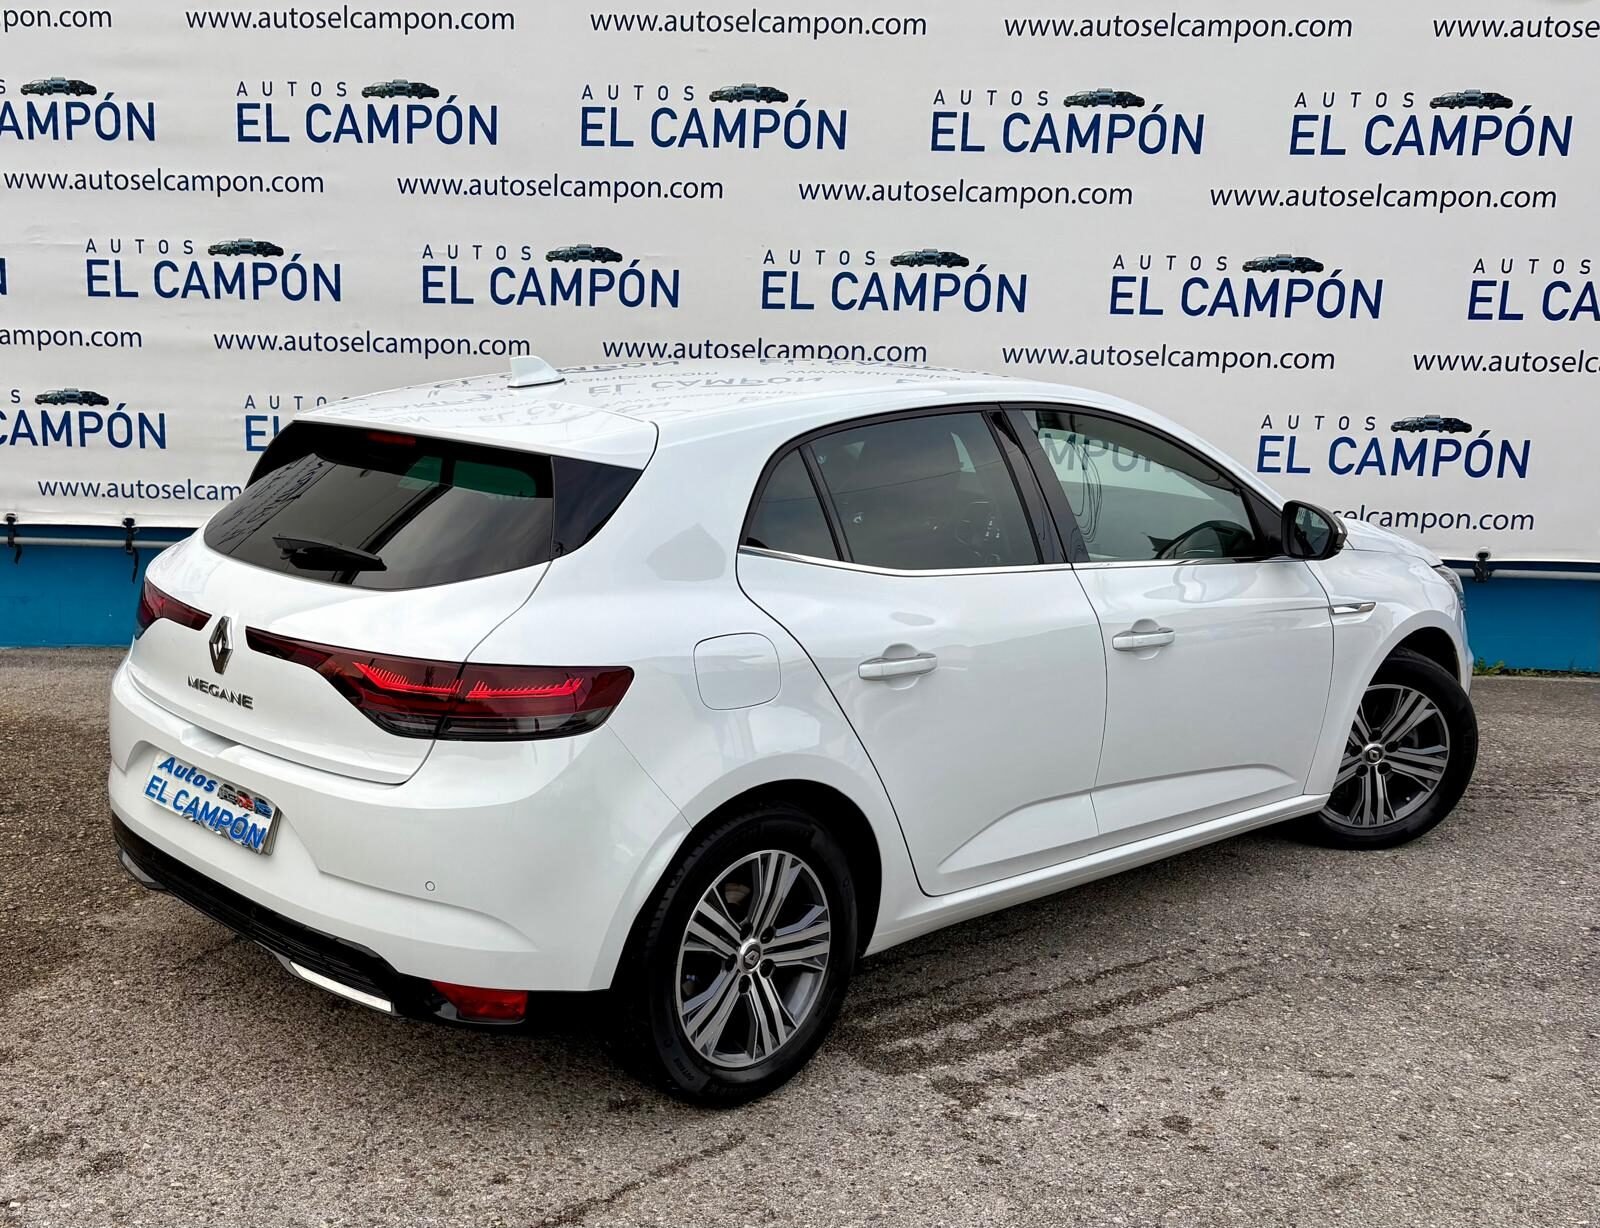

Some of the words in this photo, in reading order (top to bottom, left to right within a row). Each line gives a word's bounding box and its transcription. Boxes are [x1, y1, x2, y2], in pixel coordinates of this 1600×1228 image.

[2, 9, 112, 33] pon.com
[185, 5, 515, 35] www.autoselcampon.com
[590, 8, 927, 41] www.autoselcampon.com
[1004, 12, 1353, 44] www.autoselcampon.com
[1433, 15, 1600, 39] www.autose
[236, 80, 347, 98] AUTOS
[581, 84, 694, 102] AUTOS
[932, 89, 1049, 107] AUTOS
[1293, 91, 1415, 109] AUTOS
[0, 92, 156, 142] AMPÓN
[236, 102, 290, 143] EL
[305, 94, 498, 146] CAMPÓN
[580, 106, 635, 148] EL
[650, 99, 847, 150] CAMPÓN
[930, 111, 986, 153] EL
[1002, 103, 1205, 155] CAMPÓN
[1289, 114, 1347, 156] EL
[1364, 104, 1573, 157] CAMPÓN
[3, 167, 324, 197] www.autoselcampon.com
[396, 172, 723, 203] www.autoselcampon.com
[798, 178, 1133, 209] www.autoselcampon.com
[1210, 182, 1557, 214] www.autoselcampon.com
[85, 238, 194, 255] AUTOS
[421, 243, 532, 261] AUTOS
[763, 249, 876, 266] AUTOS
[86, 258, 139, 298] EL
[153, 254, 342, 302] CAMPÓN
[1112, 254, 1228, 272] AUTOS
[1472, 257, 1592, 275] AUTOS
[422, 265, 475, 305] EL
[490, 259, 680, 309] CAMPÓN
[761, 270, 815, 310] EL
[831, 264, 1028, 313] CAMPÓN
[1109, 275, 1164, 316] EL
[1180, 268, 1384, 320] CAMPÓN
[1467, 279, 1524, 321] EL
[1542, 280, 1600, 322] CA
[0, 328, 142, 352] ampon.com
[213, 330, 530, 360] www.autoselcampon.com
[602, 337, 927, 363] www.autoselcampon.com
[1002, 343, 1335, 374] www.autoselcampon.com
[1413, 349, 1599, 374] www.autoselc
[244, 394, 327, 411] AUTO
[1260, 414, 1376, 432] AUTOS
[1256, 435, 1311, 474] EL
[1328, 429, 1531, 479] CAMPÓN
[37, 478, 242, 501] www.autoselcam
[187, 675, 254, 710] MEGANE
[158, 756, 218, 793] Autos
[144, 774, 168, 804] EL
[172, 788, 267, 849] CAMPÓN
